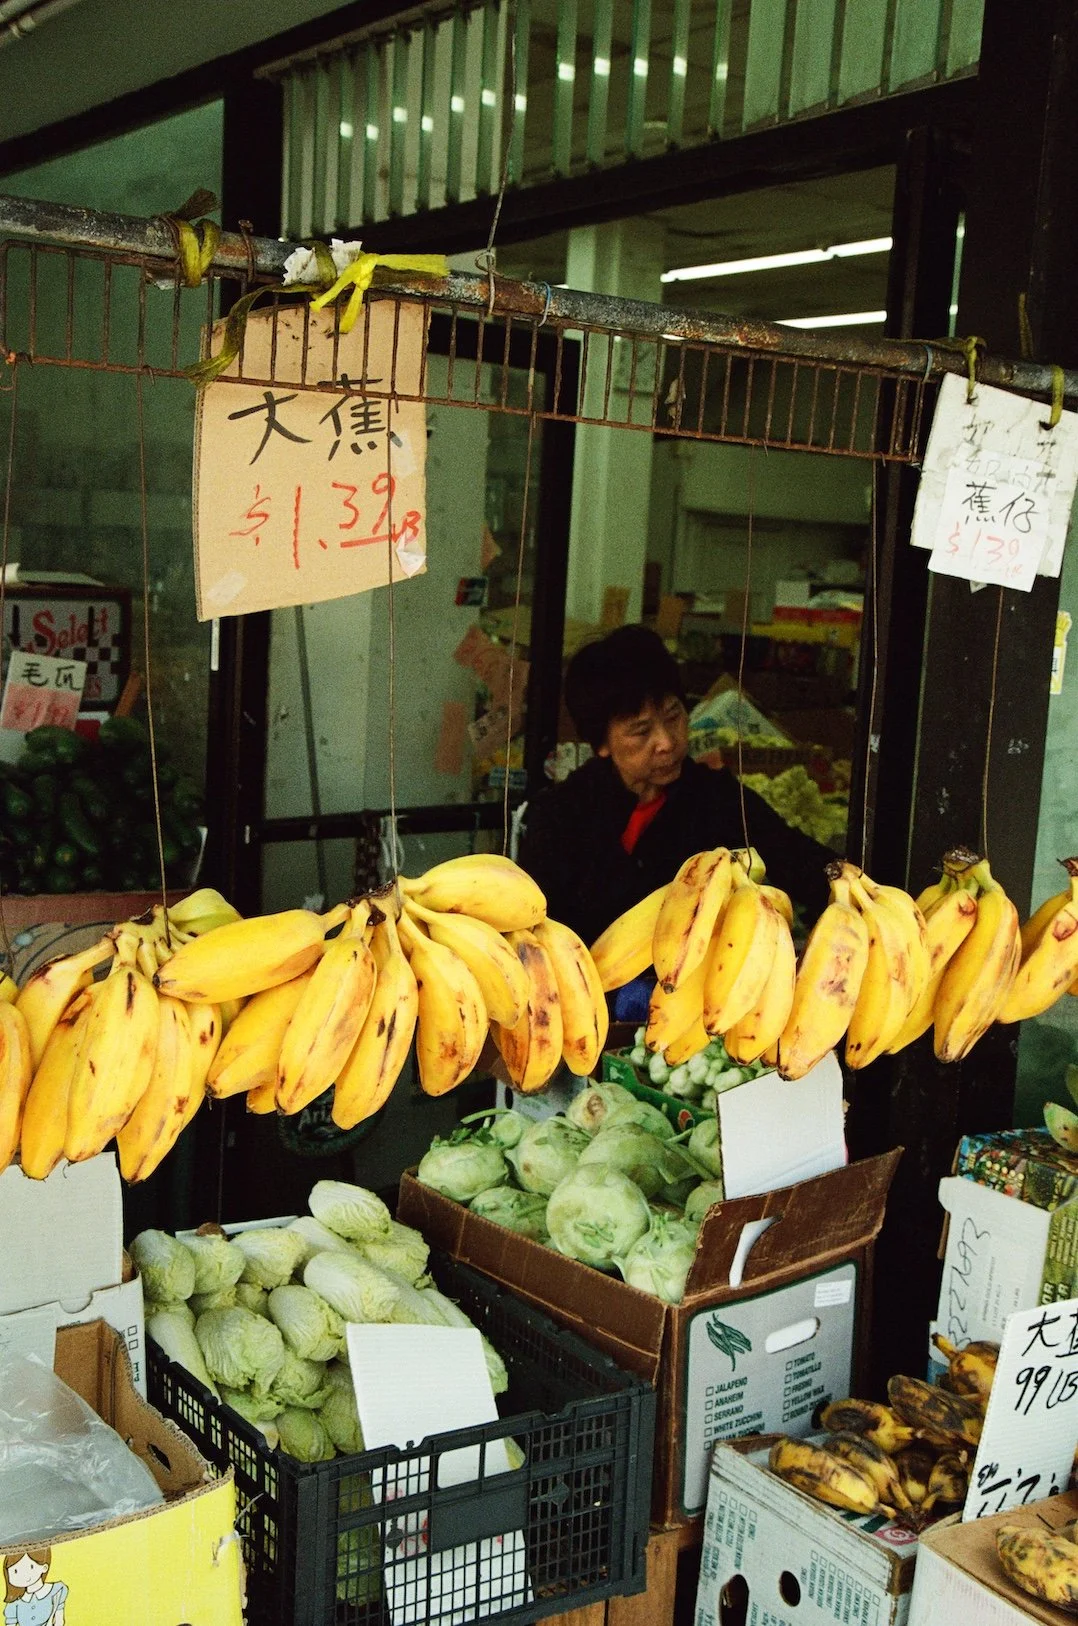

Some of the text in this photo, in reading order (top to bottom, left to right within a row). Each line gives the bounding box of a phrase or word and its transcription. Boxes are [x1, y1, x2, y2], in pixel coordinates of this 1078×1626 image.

[227, 373, 403, 466] 大蕉
[715, 1376, 748, 1394] JALAPENO
[715, 1391, 744, 1408] ANAHEIM
[713, 1404, 744, 1422] SERRANO
